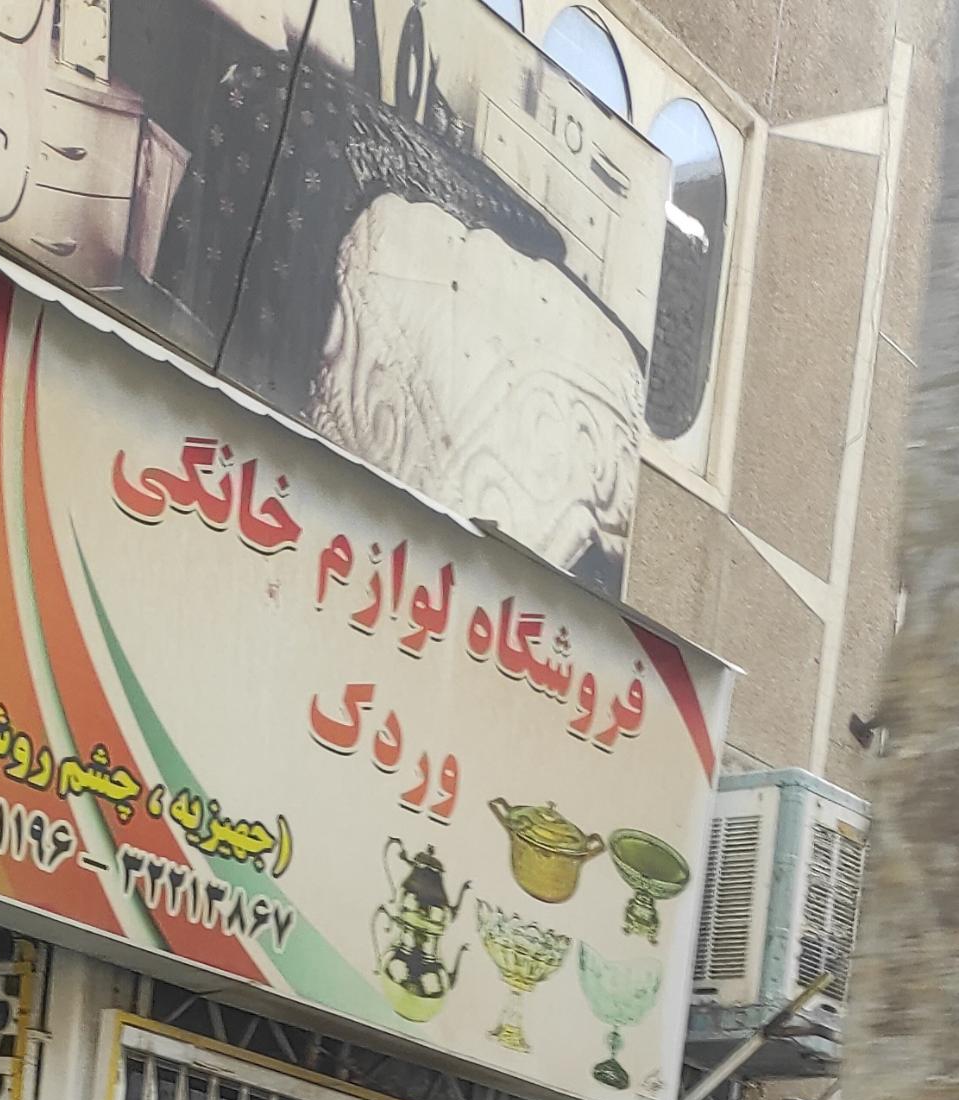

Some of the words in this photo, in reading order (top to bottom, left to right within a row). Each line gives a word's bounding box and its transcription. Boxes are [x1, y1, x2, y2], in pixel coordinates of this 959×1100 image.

[112, 436, 304, 552] خانگی
[316, 534, 455, 655] لوازم
[467, 597, 645, 749] فروشگاه
[58, 743, 142, 824] چشم
